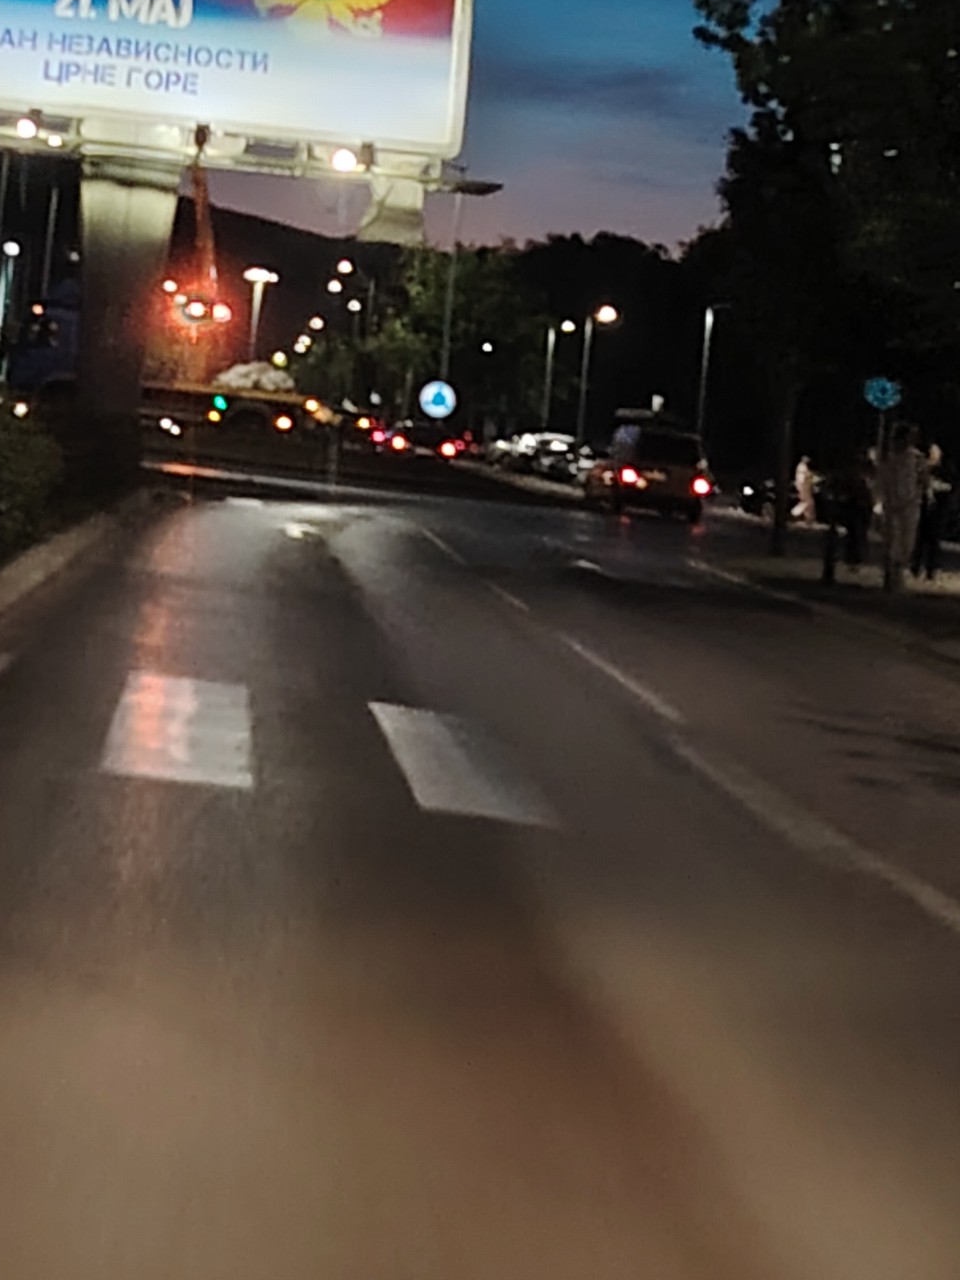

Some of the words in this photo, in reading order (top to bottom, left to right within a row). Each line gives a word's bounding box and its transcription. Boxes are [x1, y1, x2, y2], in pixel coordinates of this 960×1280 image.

[48, 32, 269, 73] НЕЗАВИСНОСТИ
[43, 60, 116, 86] ЦРНЕ
[126, 65, 198, 95] ГОРЕ
